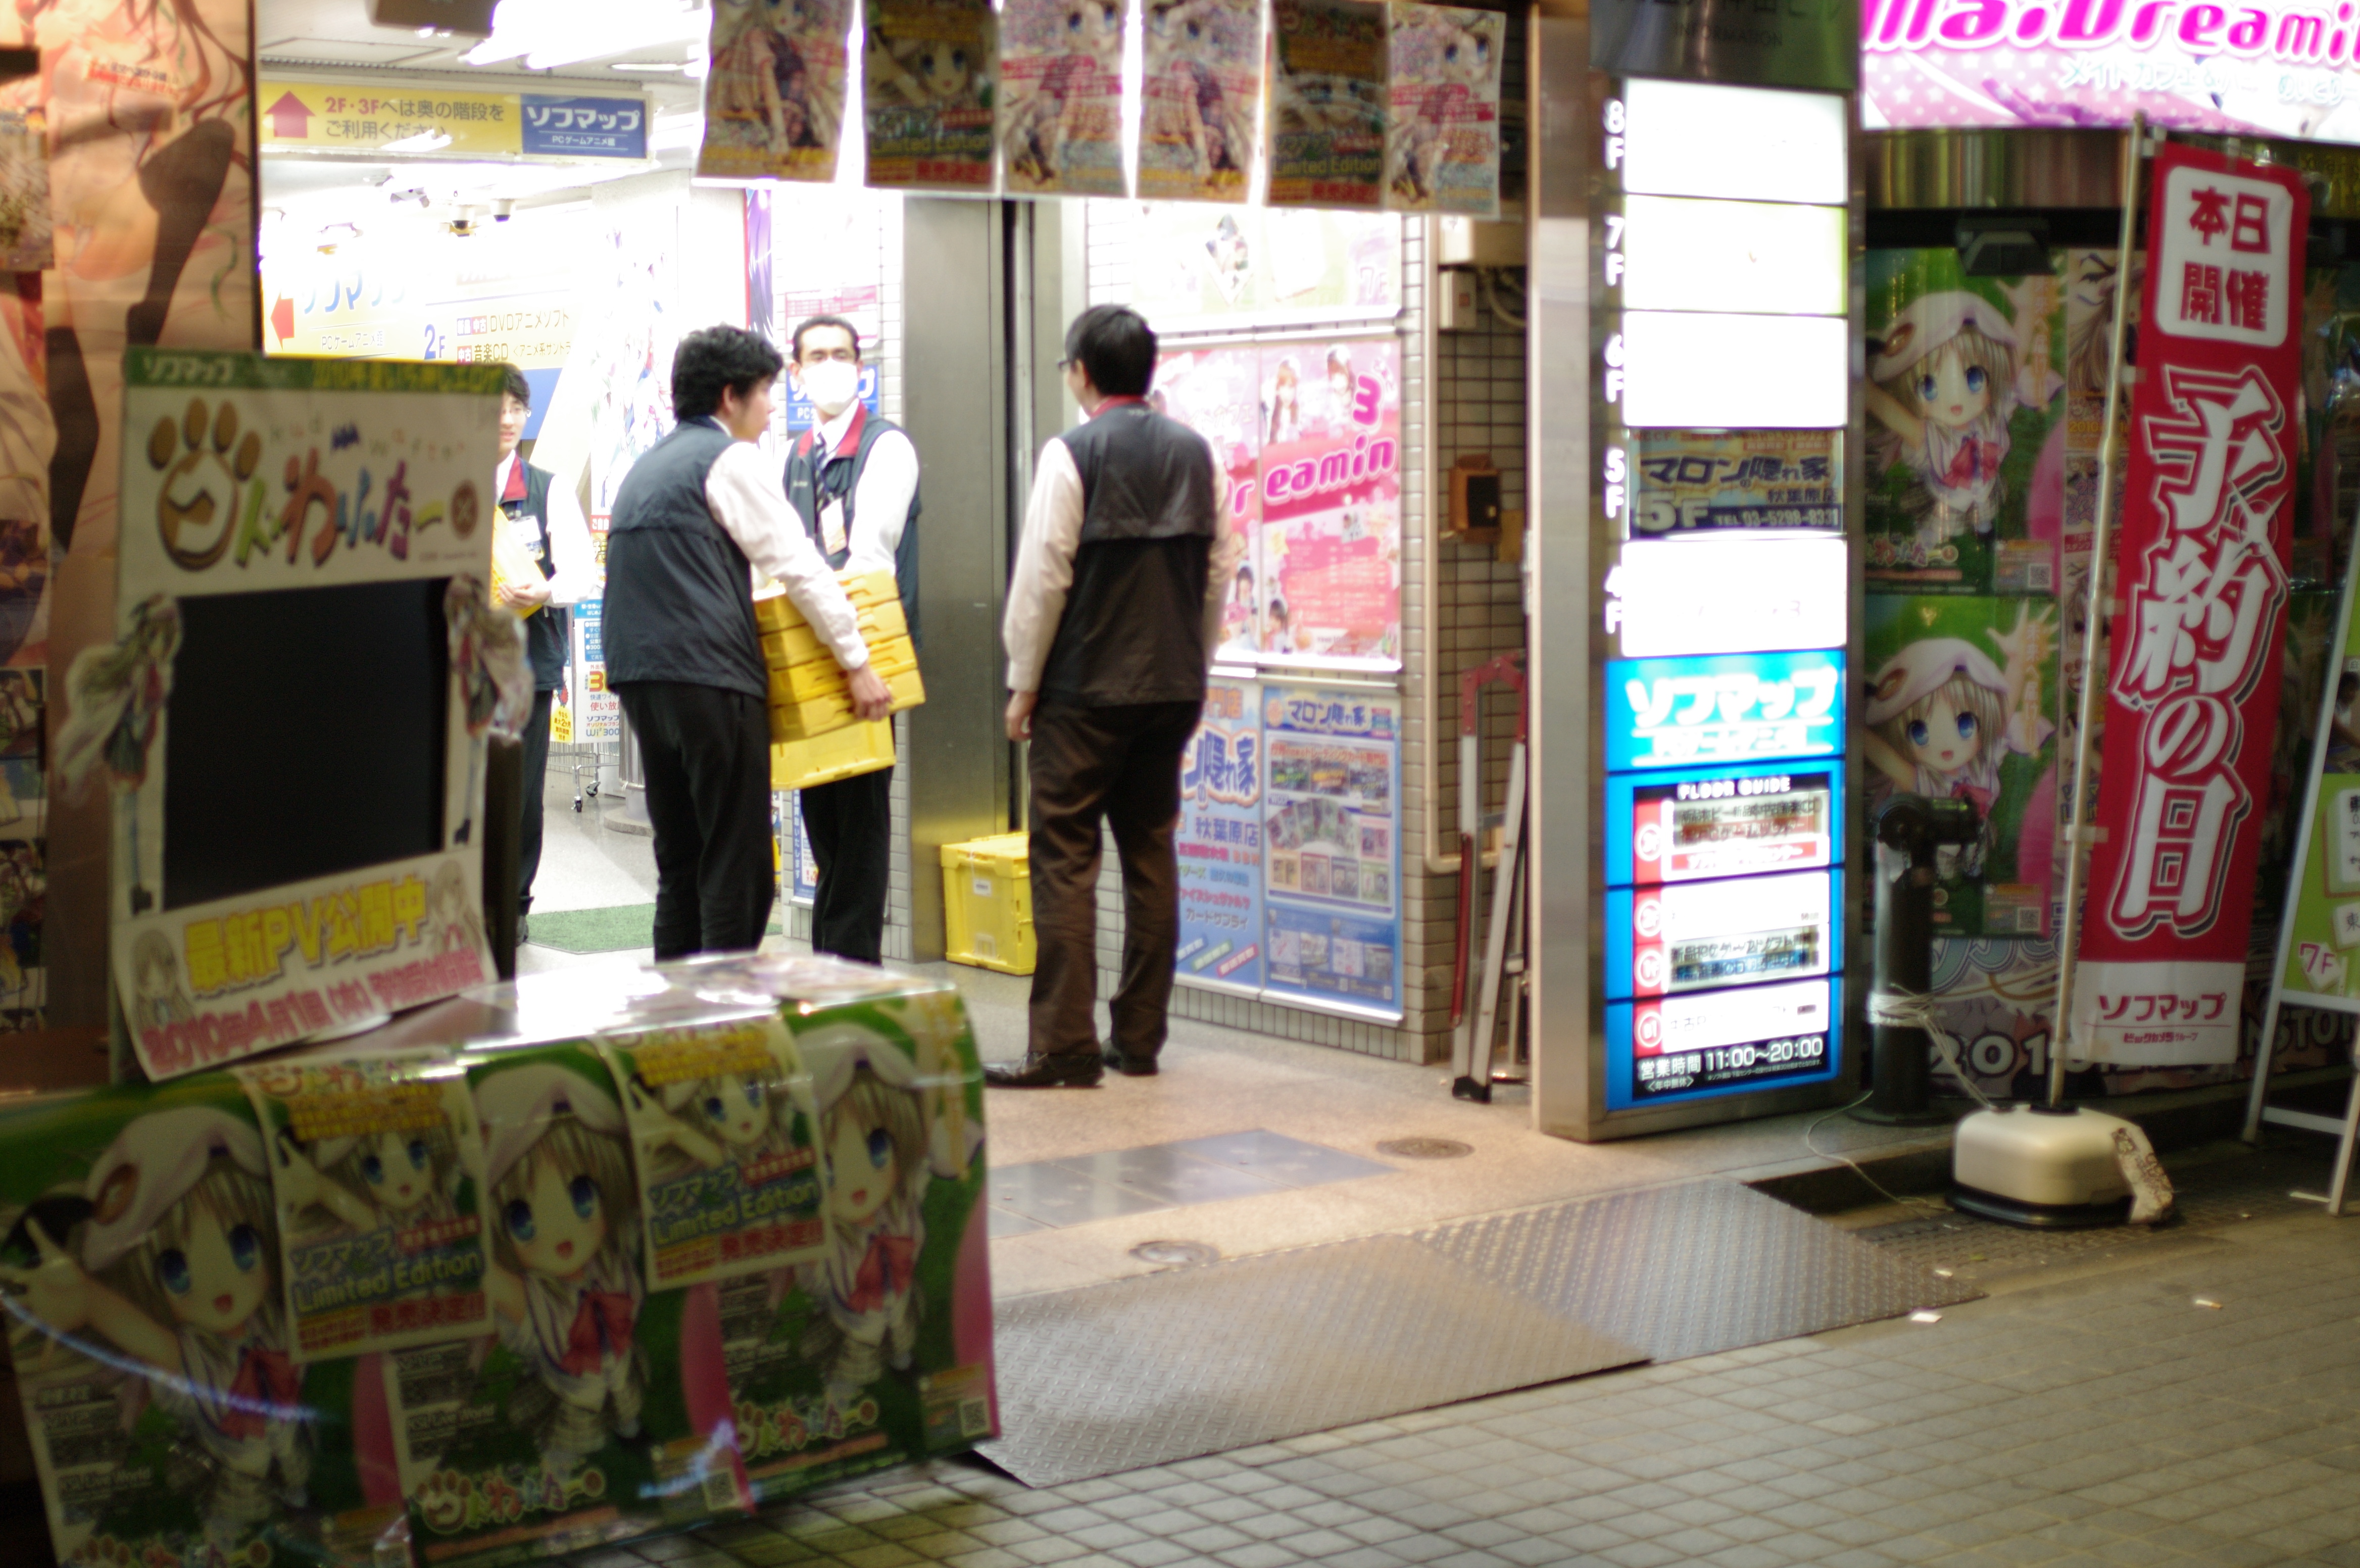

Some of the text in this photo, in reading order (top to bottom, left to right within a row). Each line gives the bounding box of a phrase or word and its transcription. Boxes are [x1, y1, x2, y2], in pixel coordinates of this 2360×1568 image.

[527, 108, 641, 131] ソフマップ
[1604, 100, 1625, 170] 8F
[2189, 185, 2272, 255] 本日
[1604, 215, 1625, 286] 7F
[2180, 260, 2271, 332] 開催
[1604, 447, 1625, 518] 5F
[1636, 489, 1711, 532] 5F
[590, 701, 620, 712] 使い放
[1624, 664, 1839, 729] ソフマップ
[1677, 776, 1791, 801] FLOOR GUIDE
[1195, 814, 1259, 848] 秋葉原店
[183, 873, 429, 992] 最新PV公開中
[2300, 943, 2336, 975] 7F
[2098, 993, 2228, 1022] ソフマップ
[1641, 1054, 1701, 1082] 営業時間
